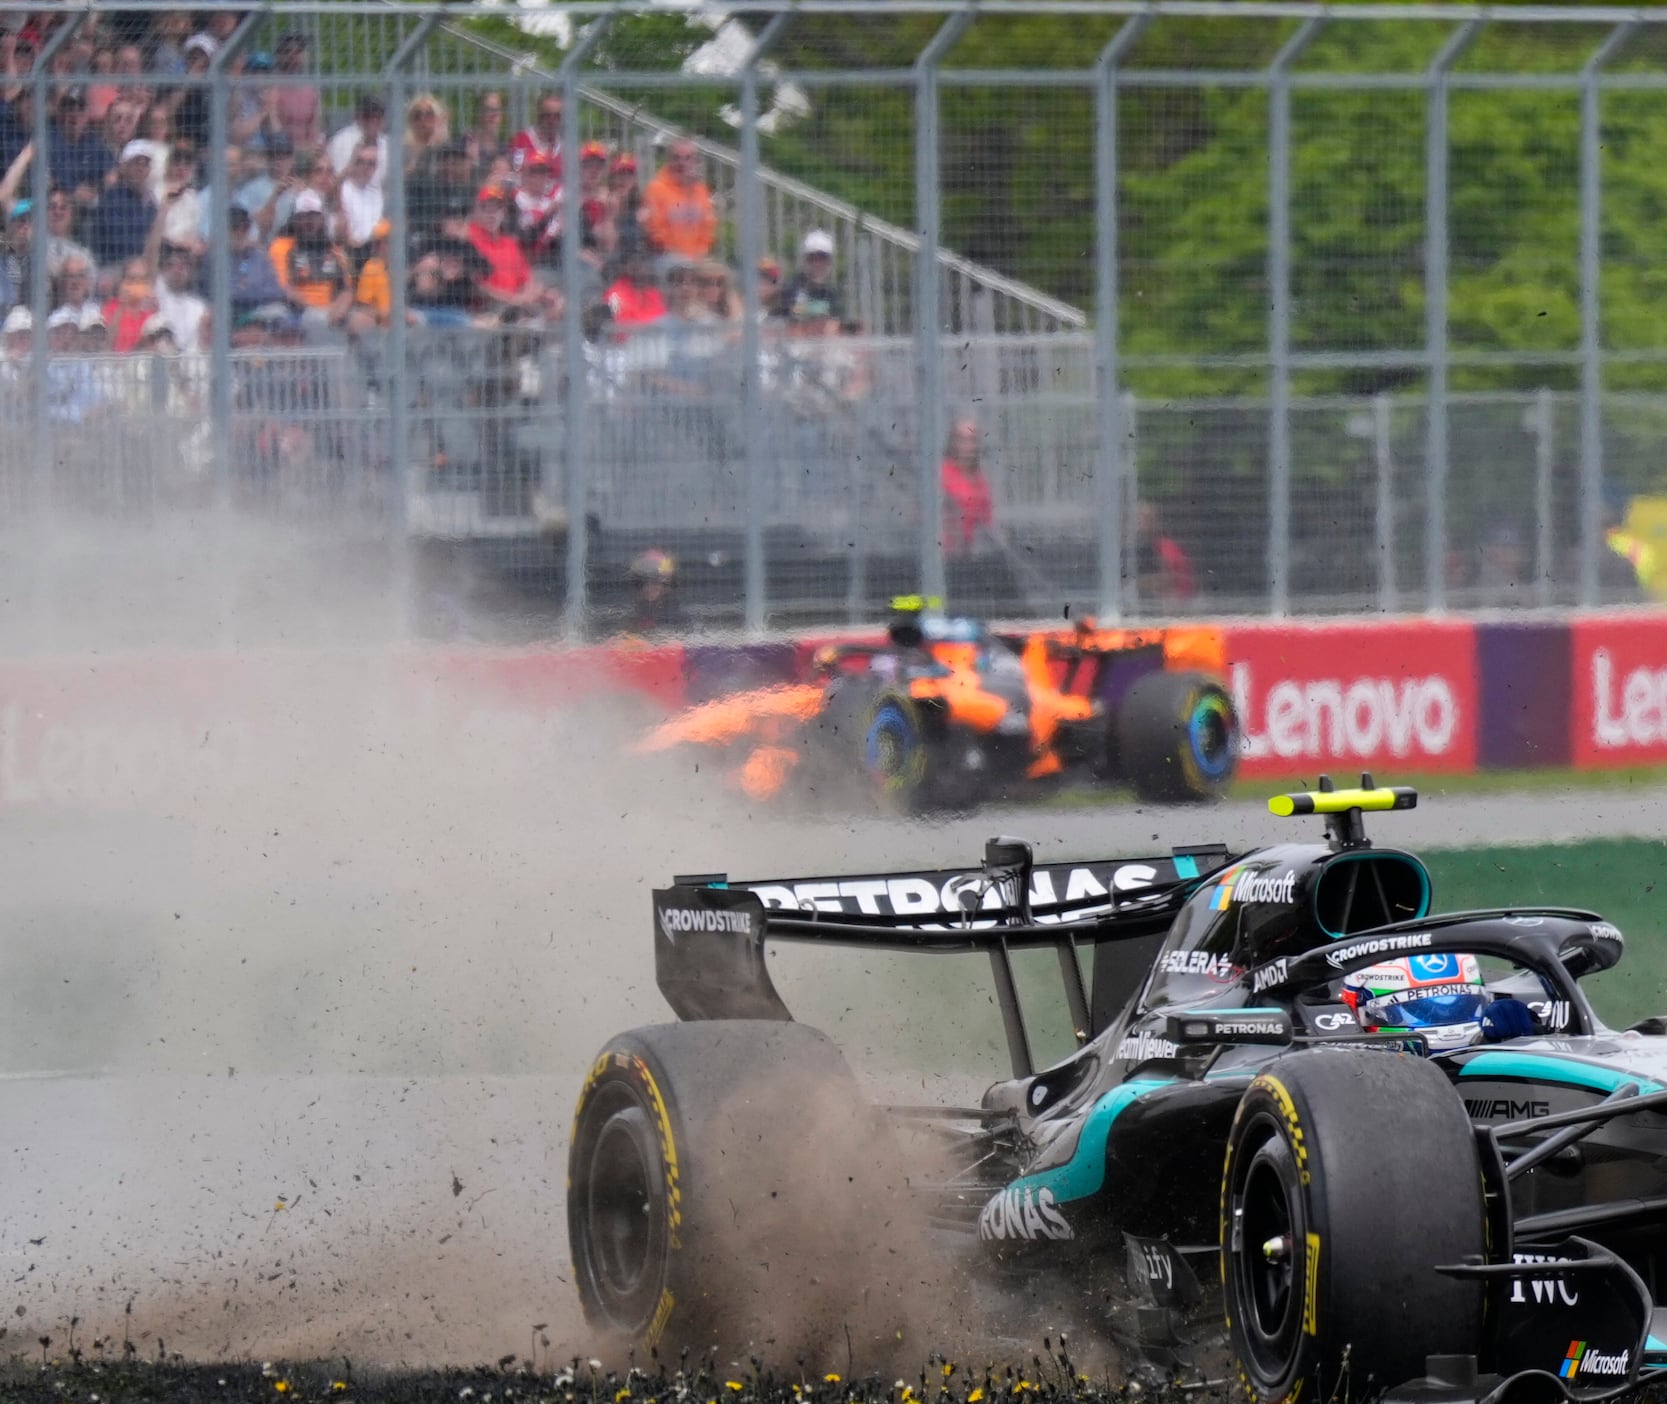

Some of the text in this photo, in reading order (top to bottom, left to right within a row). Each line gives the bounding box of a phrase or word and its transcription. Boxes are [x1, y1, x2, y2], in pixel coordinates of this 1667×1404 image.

[1234, 661, 1457, 758] Lenovo
[1233, 869, 1295, 904] Microsoft
[666, 909, 751, 934] CROWDSTRIKE
[1331, 934, 1432, 962] CROWDSTRIKE
[1169, 951, 1218, 974] SOLERA
[1253, 965, 1277, 993] AMD
[1407, 985, 1472, 1001] PETRONAS
[1215, 1022, 1284, 1035] PETRONAS
[1314, 1012, 1356, 1030] G42
[1490, 1101, 1549, 1119] AMG
[1510, 1253, 1579, 1306] IWC
[1580, 1348, 1629, 1376] Microsoft
